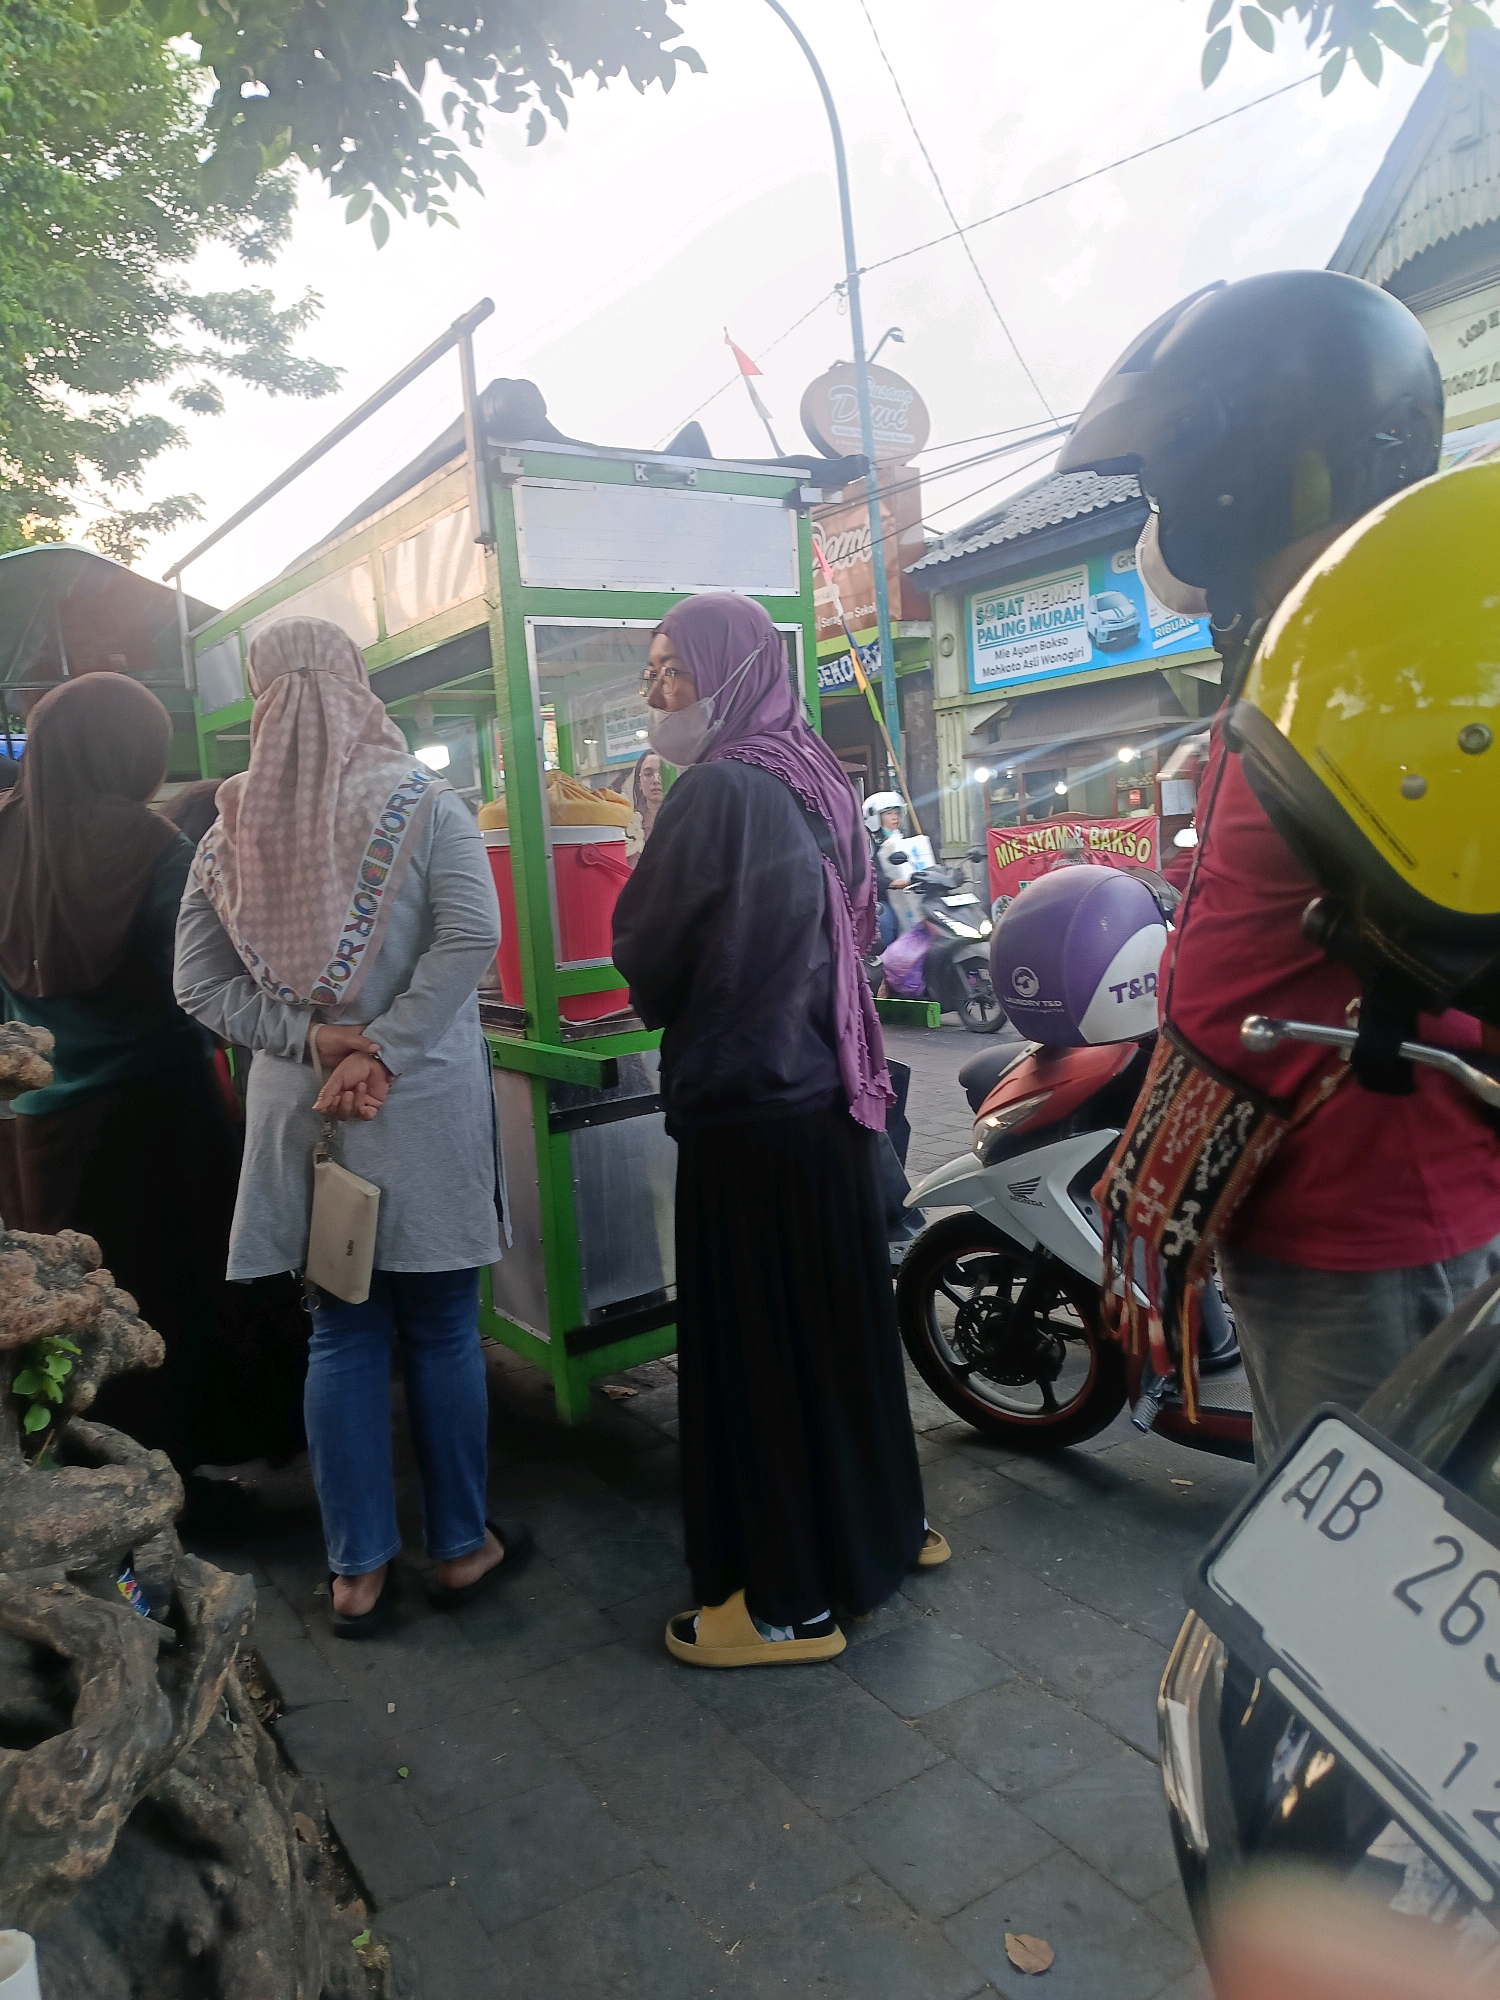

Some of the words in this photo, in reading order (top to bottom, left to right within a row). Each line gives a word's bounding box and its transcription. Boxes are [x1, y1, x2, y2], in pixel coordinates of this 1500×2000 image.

[827, 384, 909, 431] Dwi
[1117, 555, 1137, 569] Gra
[854, 602, 877, 617] Sekol
[976, 599, 1026, 626] SOBAT
[1027, 579, 1085, 613] HEMAT
[977, 621, 1026, 645] PALING
[1029, 603, 1085, 632] MURAH
[982, 660, 1022, 678] Mahkota
[1023, 656, 1040, 671] Asli
[1040, 647, 1085, 668] Wonogiri
[994, 645, 1011, 660] Mie
[1012, 640, 1039, 660] Ayam
[1040, 636, 1069, 653] Bakso
[995, 836, 1025, 869] MIE
[1026, 825, 1068, 855] AYAM
[1088, 826, 1152, 863] BAKSO
[1009, 1194, 1047, 1208] HONDA
[1281, 1446, 1384, 1542] AB
